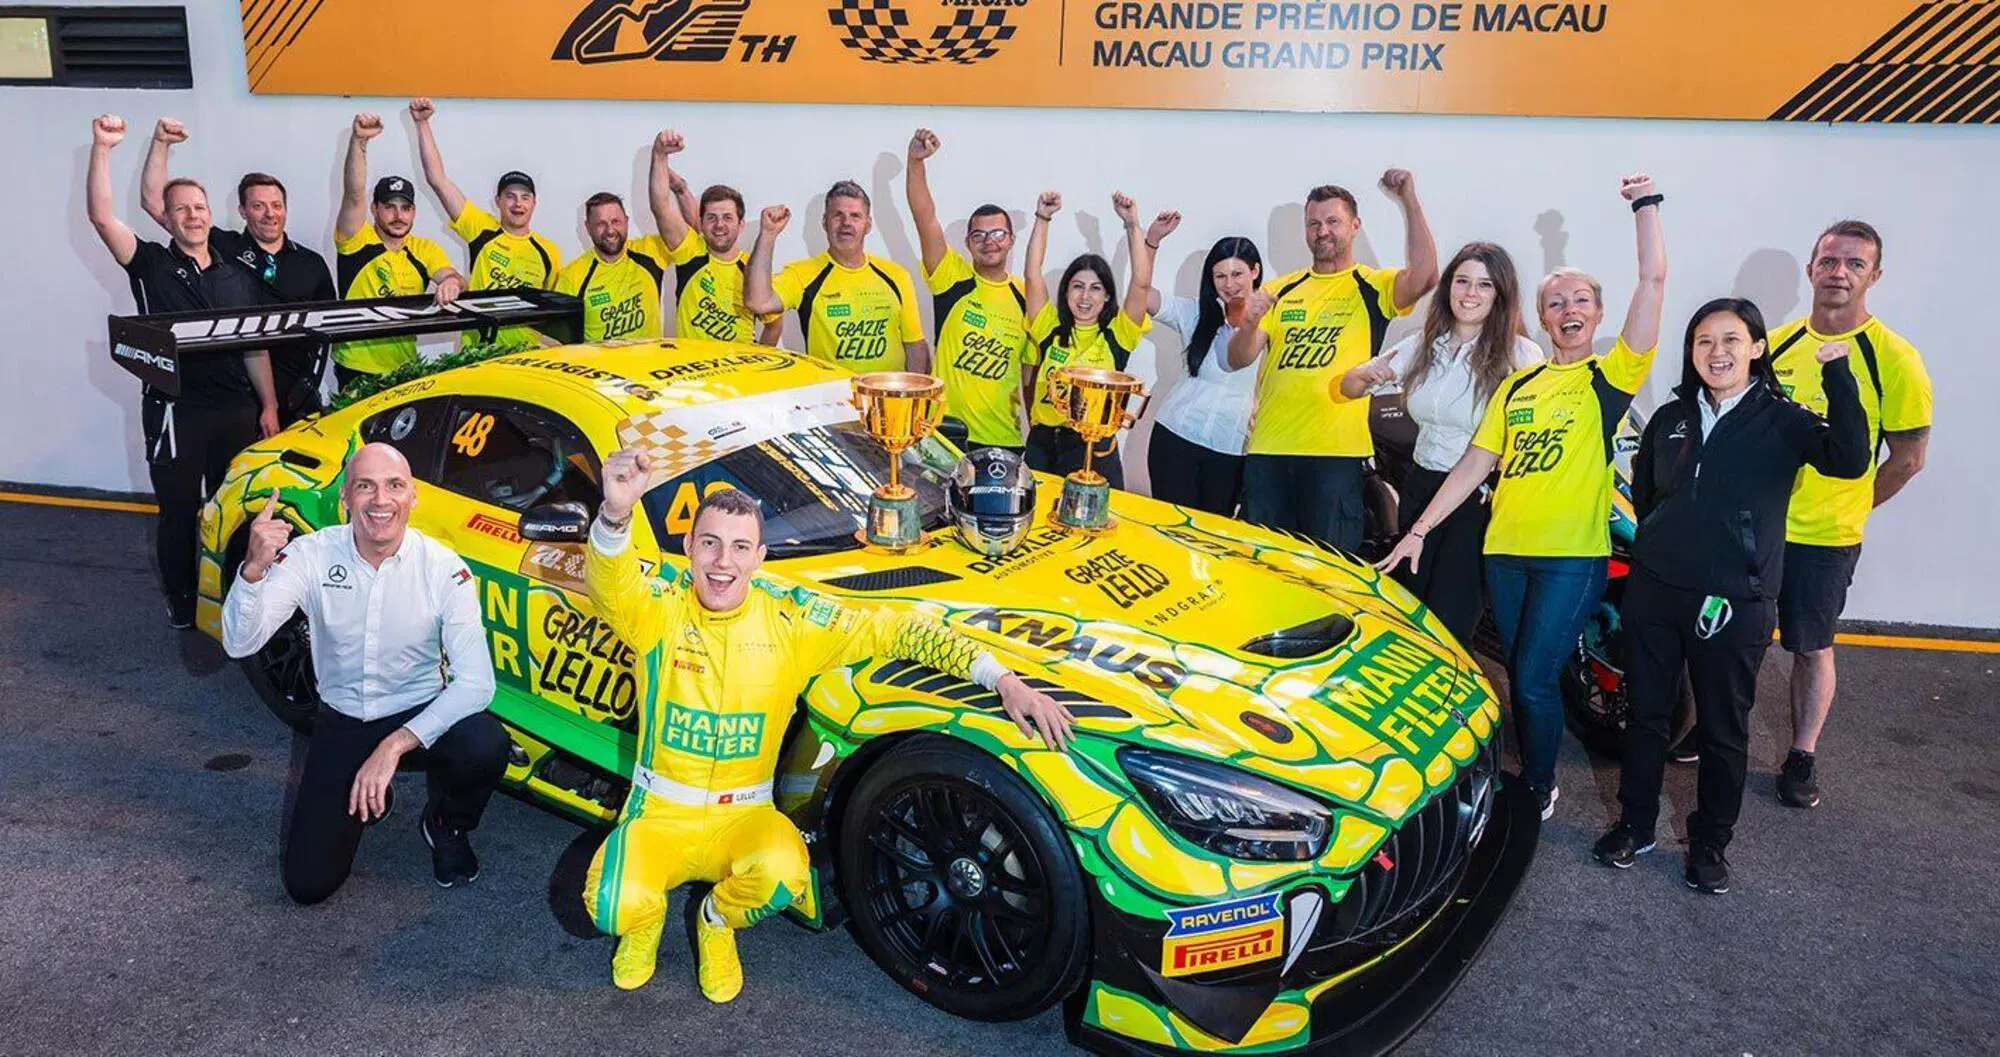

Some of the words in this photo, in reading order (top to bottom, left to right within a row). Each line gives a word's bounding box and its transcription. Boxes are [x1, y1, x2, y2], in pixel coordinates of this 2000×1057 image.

[1095, 2, 1243, 30] GRANDE
[1411, 3, 1462, 31] DE
[1472, 3, 1607, 33] MACAU
[739, 35, 797, 63] TH
[1093, 40, 1212, 67] MACAU
[1222, 41, 1350, 69] GRAND
[1362, 43, 1445, 71] PRIX
[600, 293, 643, 322] GRAZIE
[603, 310, 646, 340] LELLO
[691, 311, 738, 342] LELLO
[835, 318, 888, 337] GRAZIE
[133, 348, 175, 372] AMG
[834, 337, 888, 360] LELLO
[962, 331, 1014, 359] GRAZIE
[1277, 345, 1338, 370] LELLO
[953, 350, 1009, 380] LELLO
[452, 411, 496, 457] 48
[1064, 548, 1135, 585] GRAZIE
[1099, 563, 1170, 609] LELLO
[543, 604, 637, 668] GRAZIE
[963, 606, 1190, 690] KNAUS
[539, 646, 638, 718] LELLO
[1328, 637, 1433, 722] MANN
[669, 706, 762, 736] MANN
[1377, 663, 1479, 755] FILTER
[665, 728, 757, 758] FILTER
[1181, 905, 1269, 930] RAVENOL
[1173, 928, 1275, 970] PIRELLI
